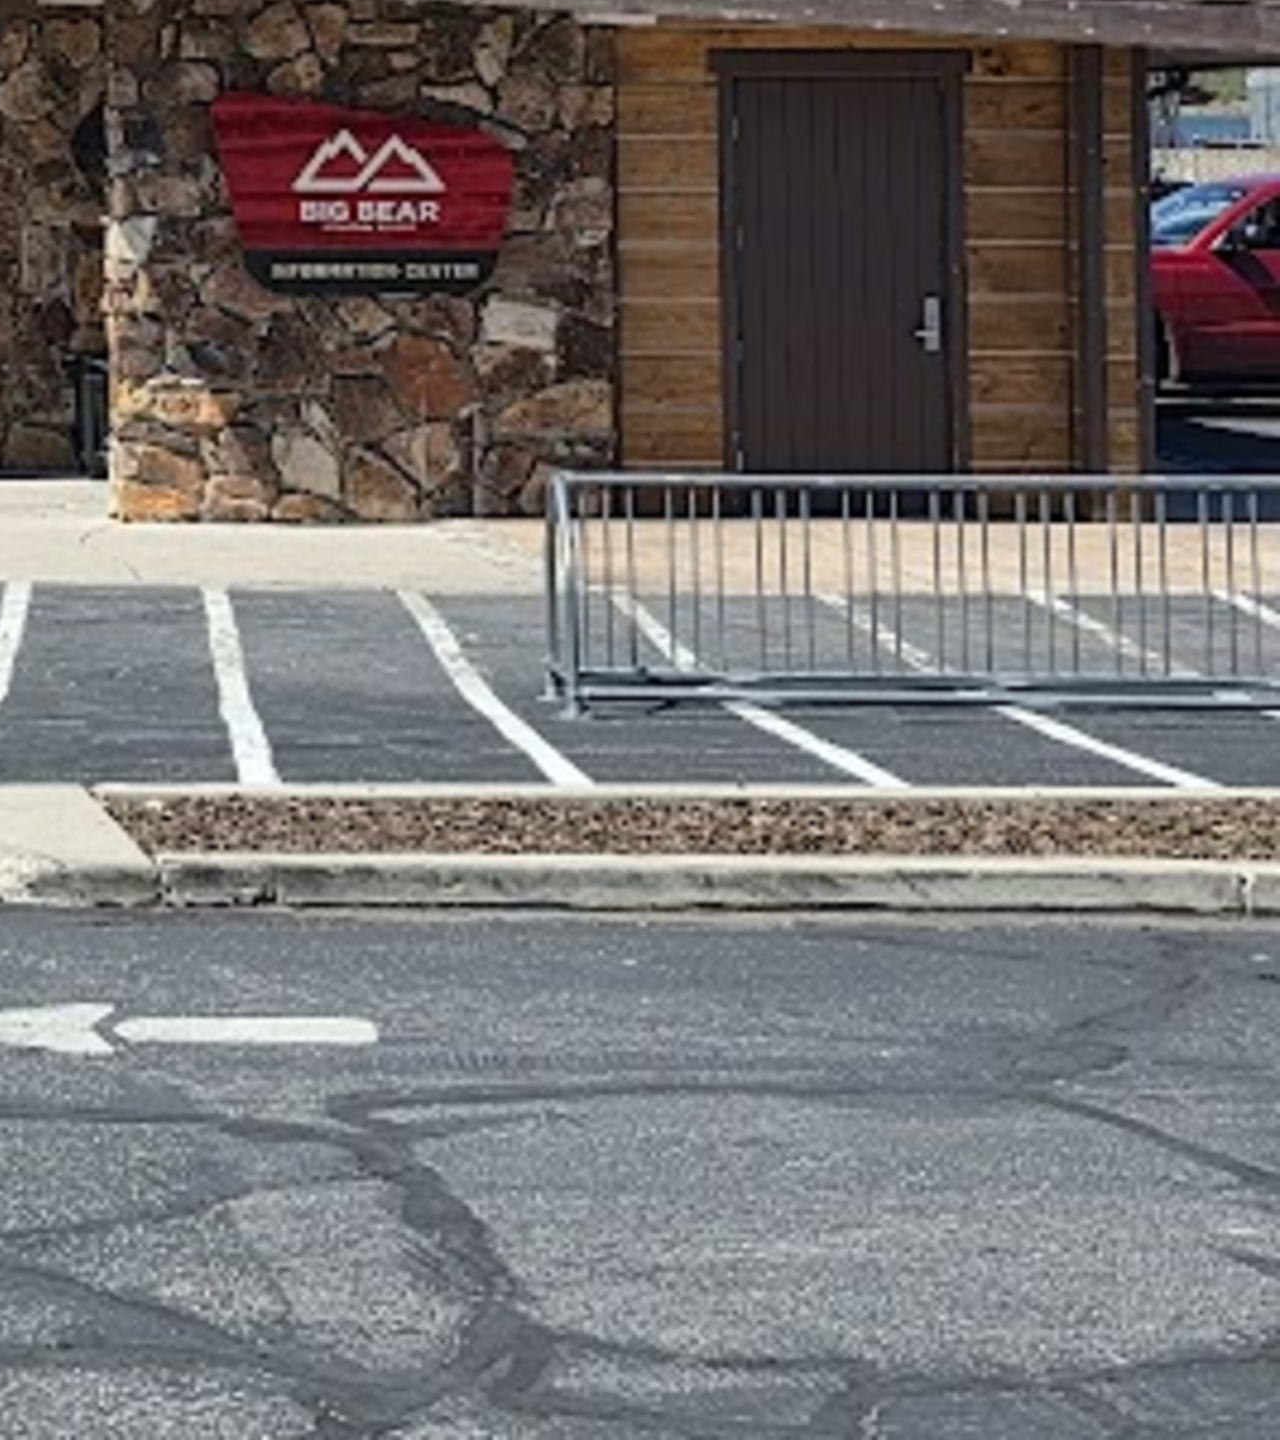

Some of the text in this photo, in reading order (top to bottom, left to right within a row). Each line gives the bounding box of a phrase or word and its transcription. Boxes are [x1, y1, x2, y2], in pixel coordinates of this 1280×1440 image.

[299, 201, 440, 223] BIG BEAR
[271, 263, 480, 280] INFORMATION CENTER
